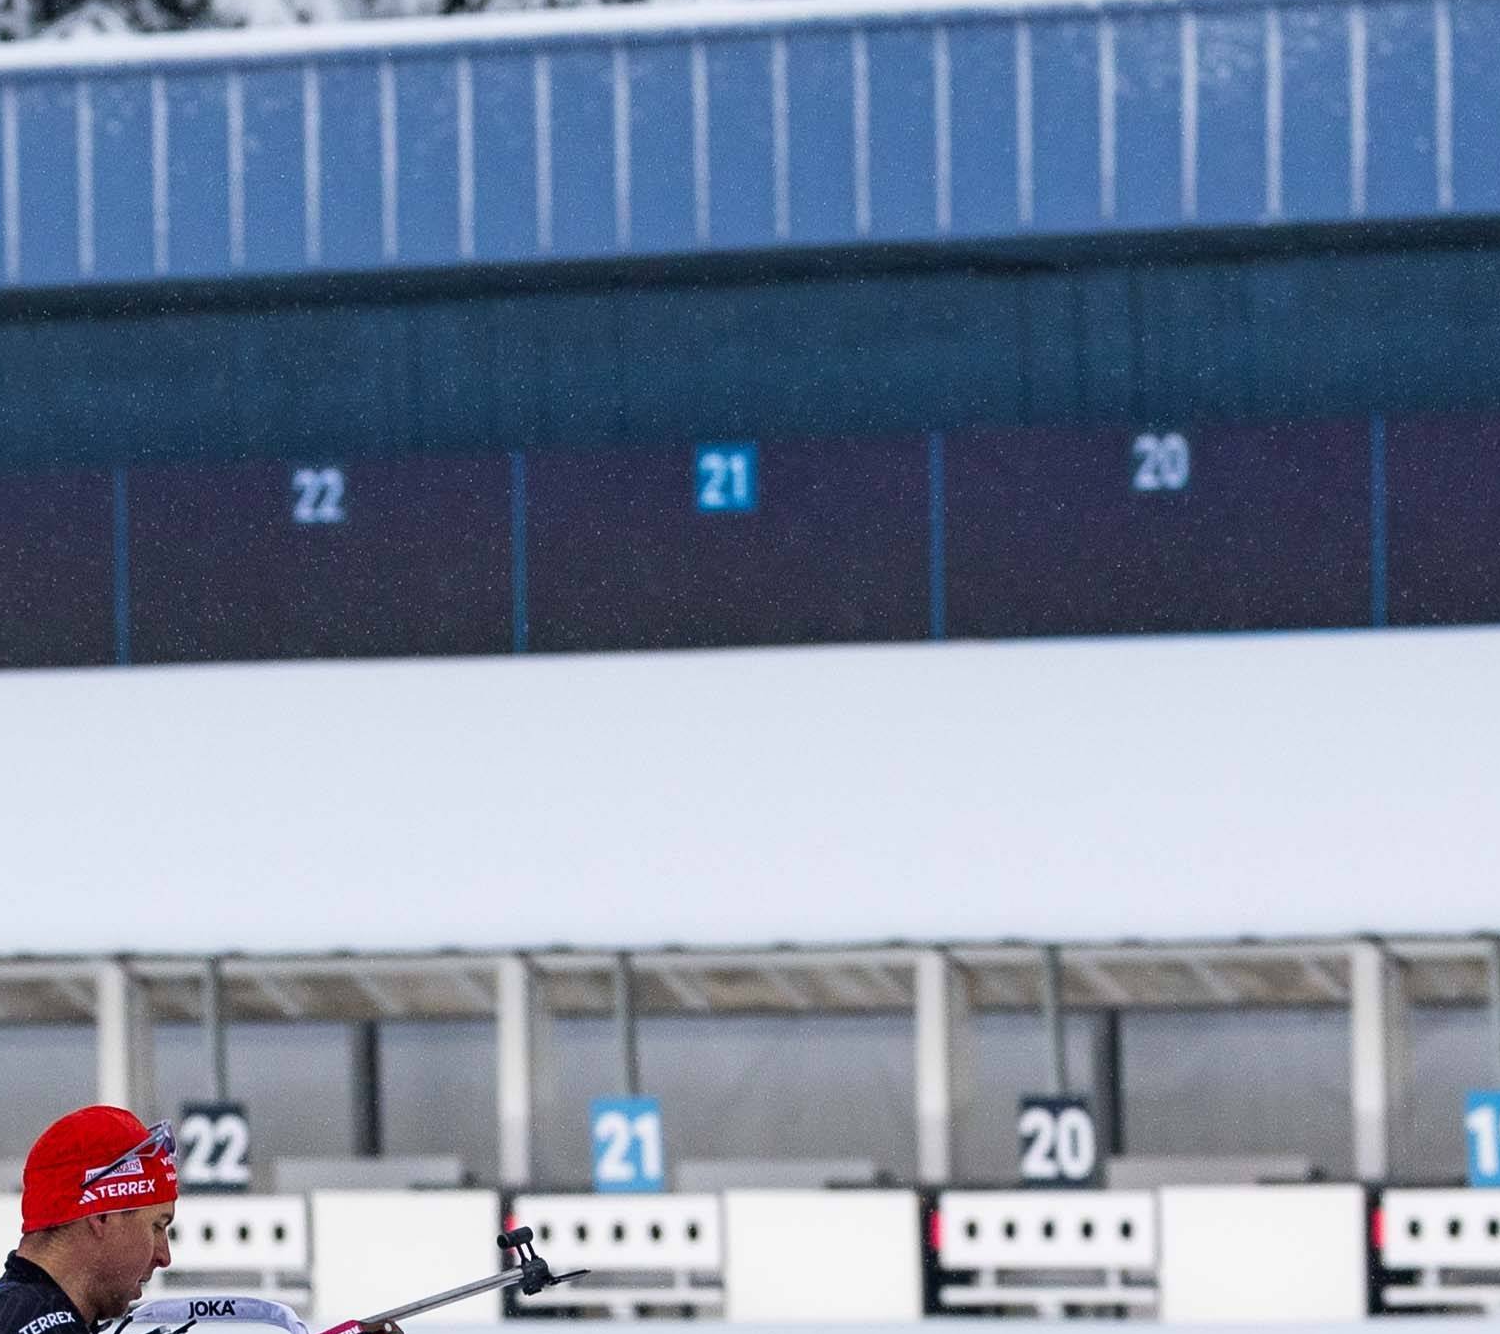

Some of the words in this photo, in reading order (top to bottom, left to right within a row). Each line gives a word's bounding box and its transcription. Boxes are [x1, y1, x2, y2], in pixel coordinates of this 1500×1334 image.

[699, 454, 748, 507] 21
[1132, 432, 1190, 489] 20
[292, 469, 343, 524] 22
[182, 1116, 250, 1185] 22
[594, 1112, 659, 1180] 21
[1020, 1107, 1095, 1178] 20
[95, 1179, 156, 1198] TERREX
[188, 1300, 235, 1318] JOKA
